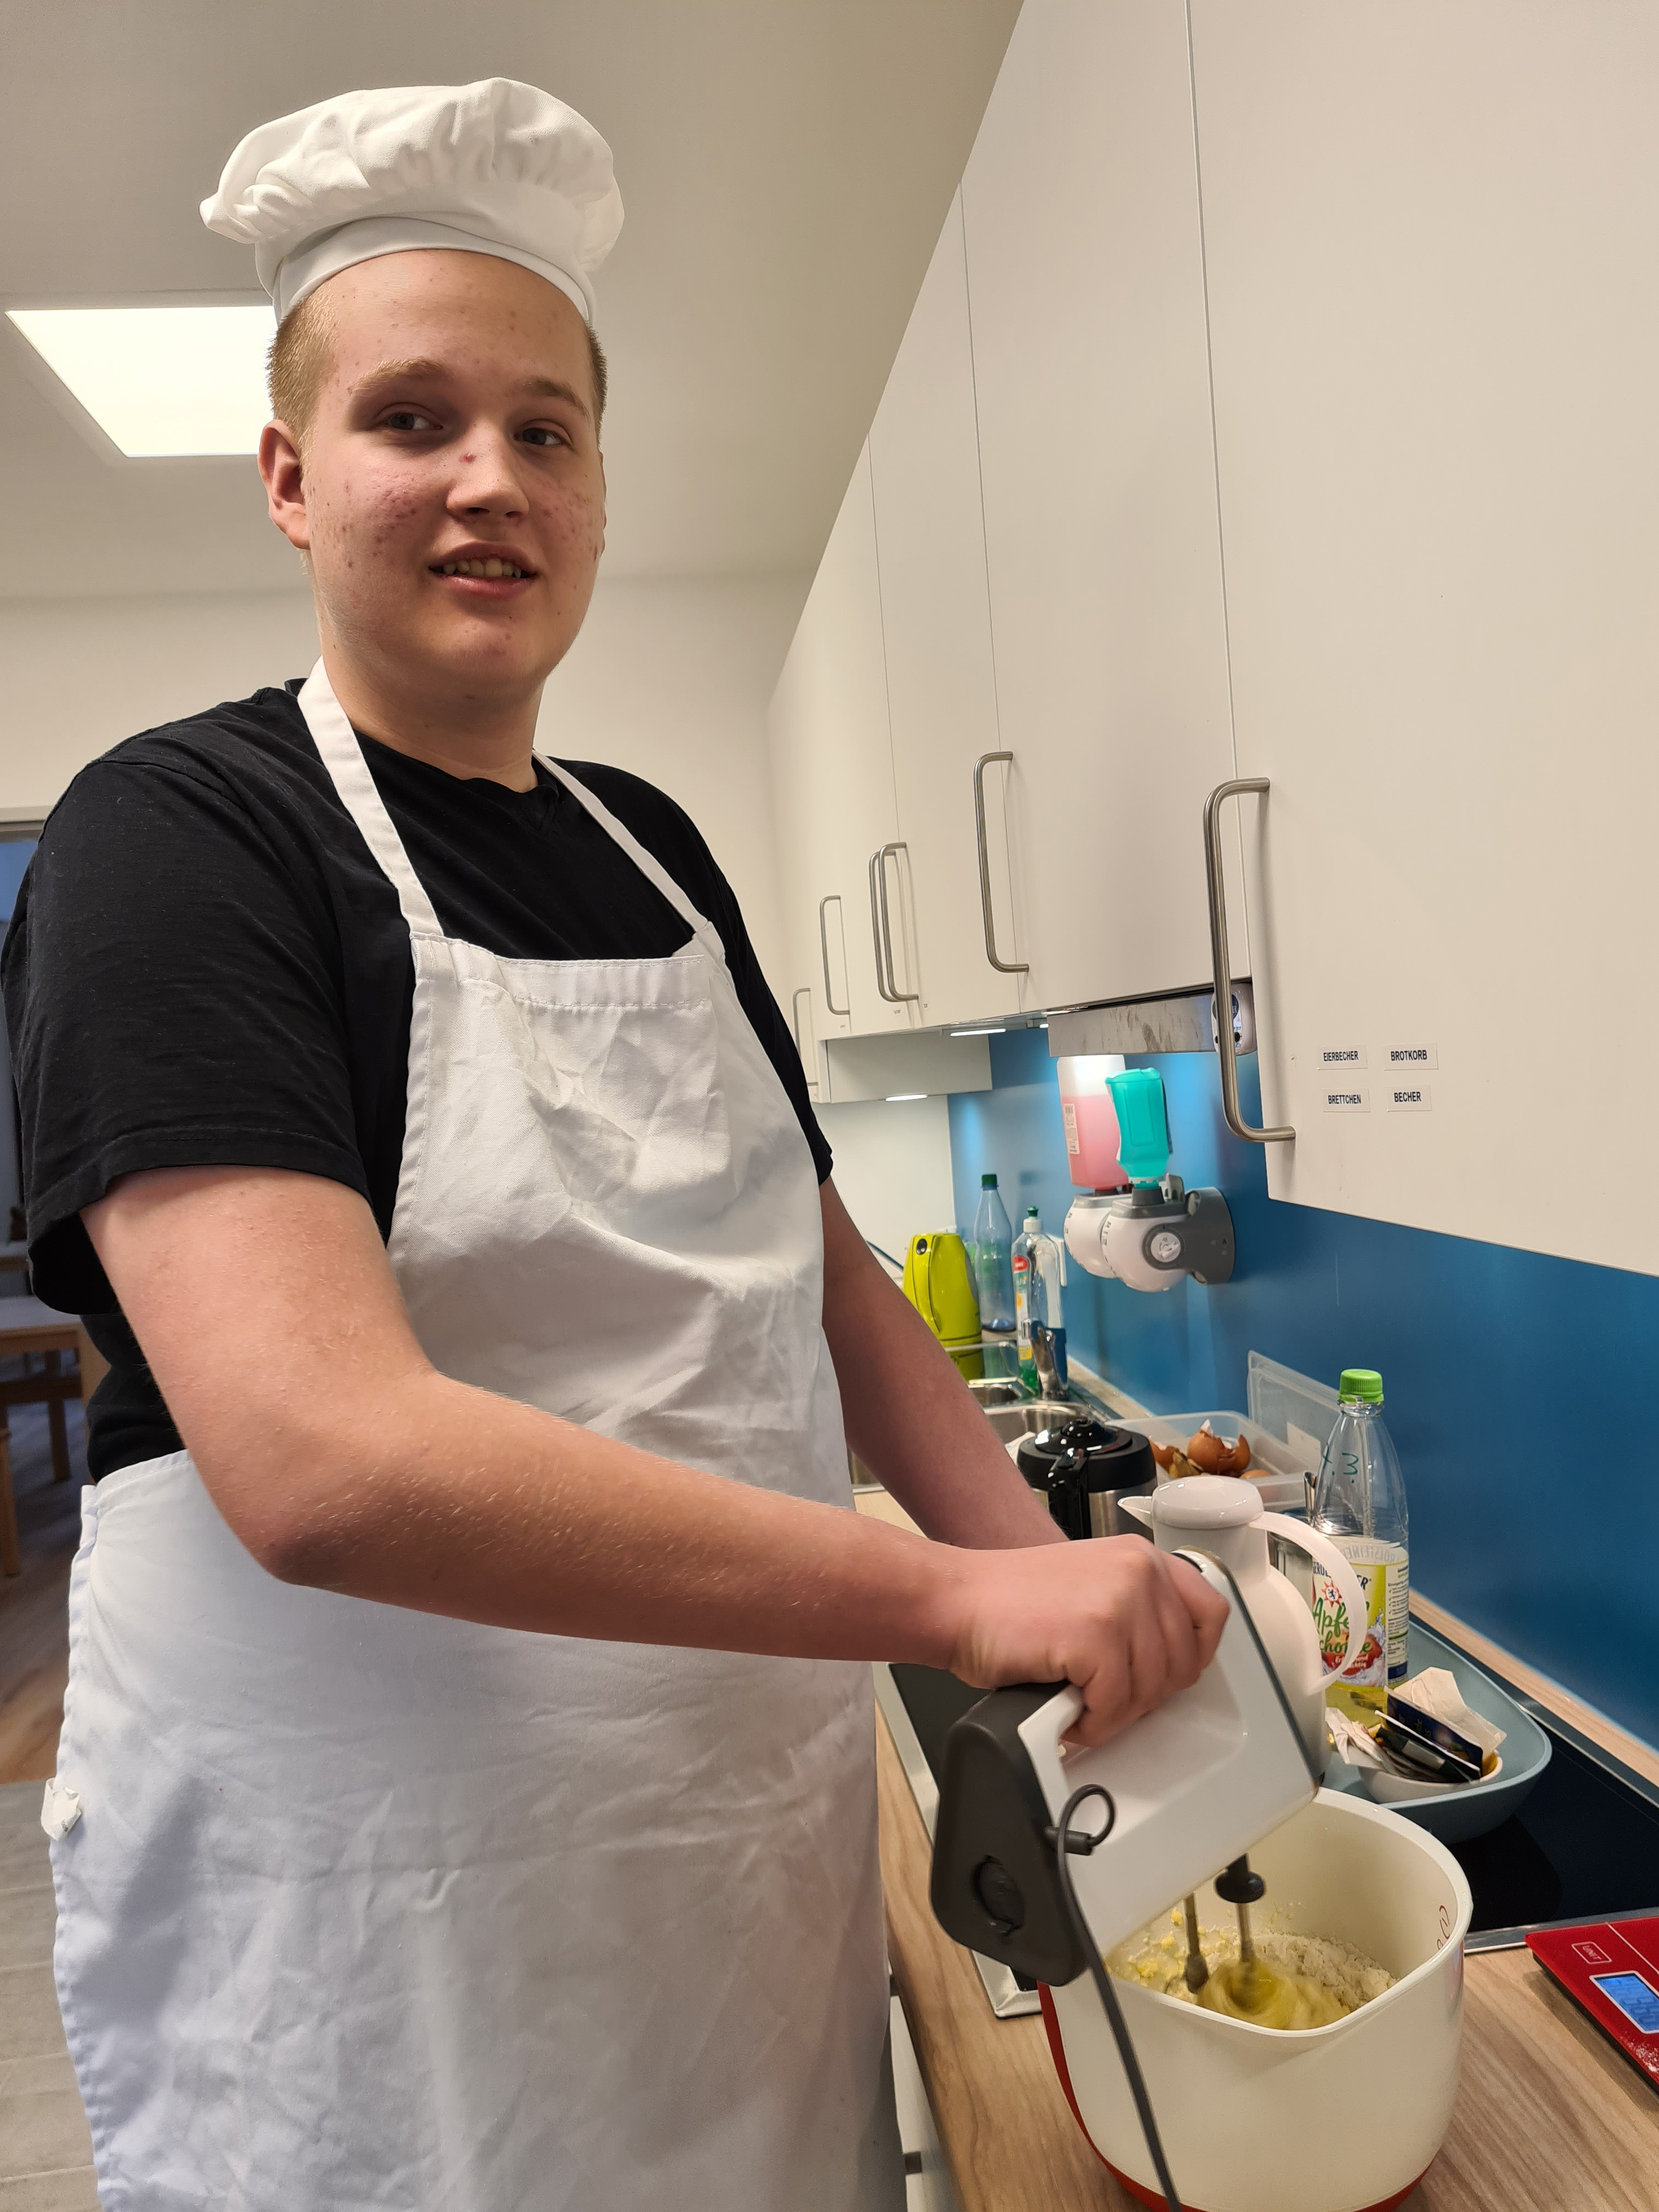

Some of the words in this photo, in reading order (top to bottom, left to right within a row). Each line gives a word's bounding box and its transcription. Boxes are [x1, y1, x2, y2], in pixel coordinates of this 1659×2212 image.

[1323, 1051, 1359, 1062] EIERBECHER
[1390, 1049, 1427, 1062] BROTKORB
[1328, 1094, 1362, 1104] BRETTCHEN
[1393, 1091, 1422, 1103] BECHER
